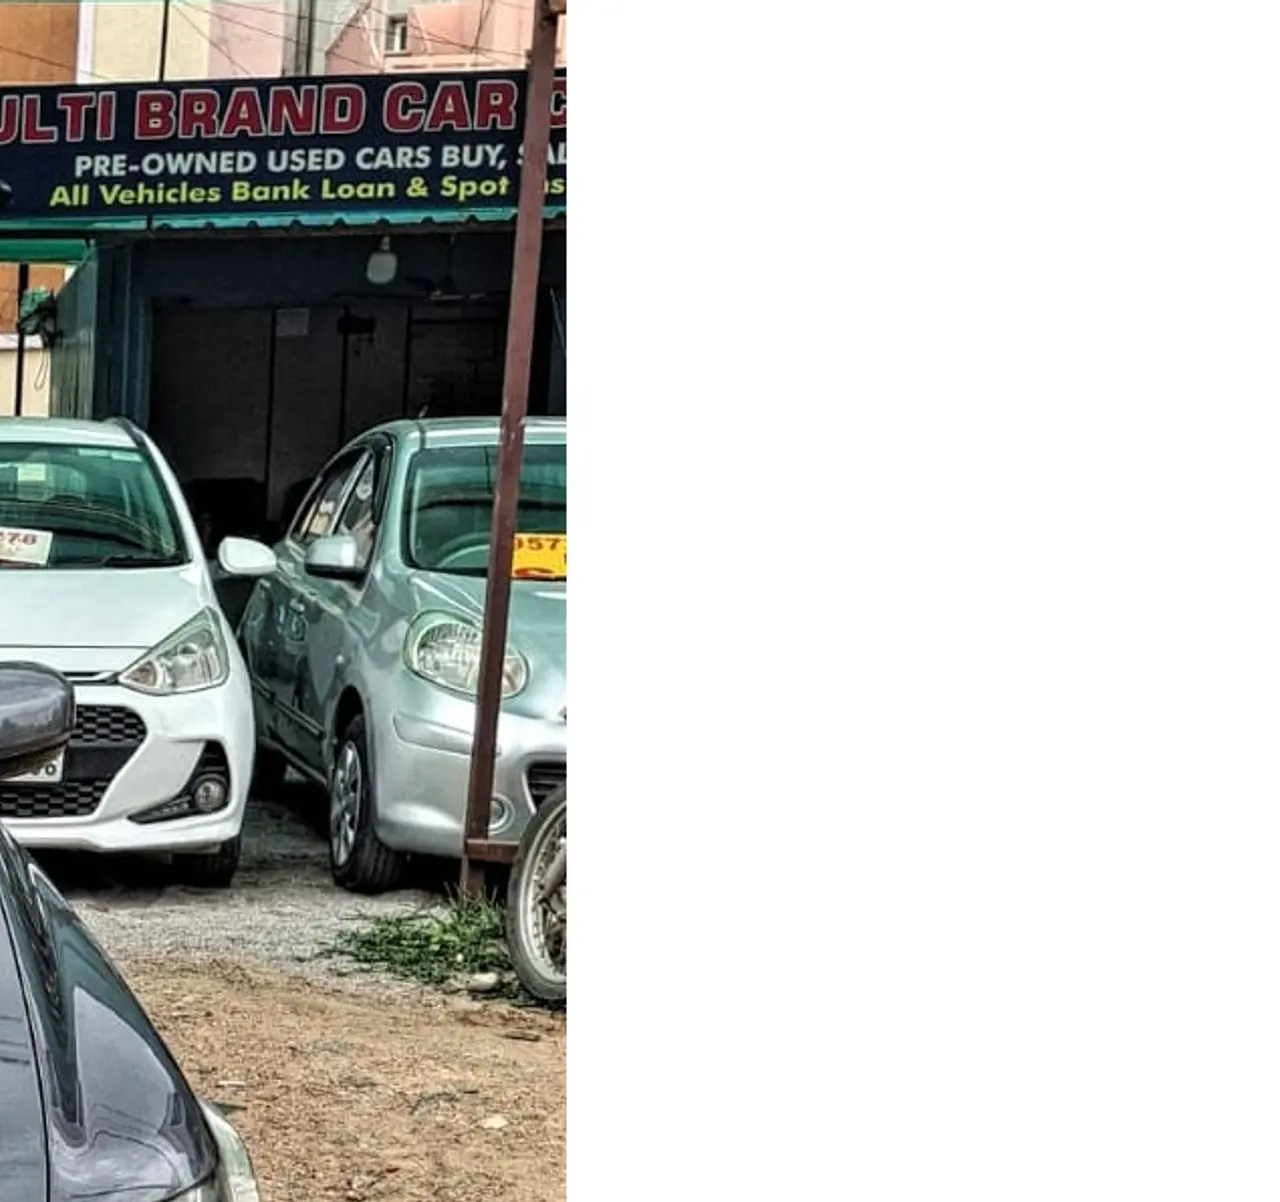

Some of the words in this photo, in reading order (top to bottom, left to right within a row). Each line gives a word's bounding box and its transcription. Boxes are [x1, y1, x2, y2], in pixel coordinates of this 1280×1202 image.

[134, 83, 367, 141] BRAND
[383, 79, 519, 133] CAR
[74, 151, 257, 178] PRE-OWNED
[267, 148, 346, 173] USED
[356, 146, 431, 170] CARS
[441, 144, 507, 170] BUY,
[49, 184, 90, 207] All
[99, 181, 222, 206] Vehicles
[232, 178, 310, 202] Bank
[322, 178, 396, 199] Loan
[406, 176, 430, 198] &
[441, 174, 512, 201] Spot
